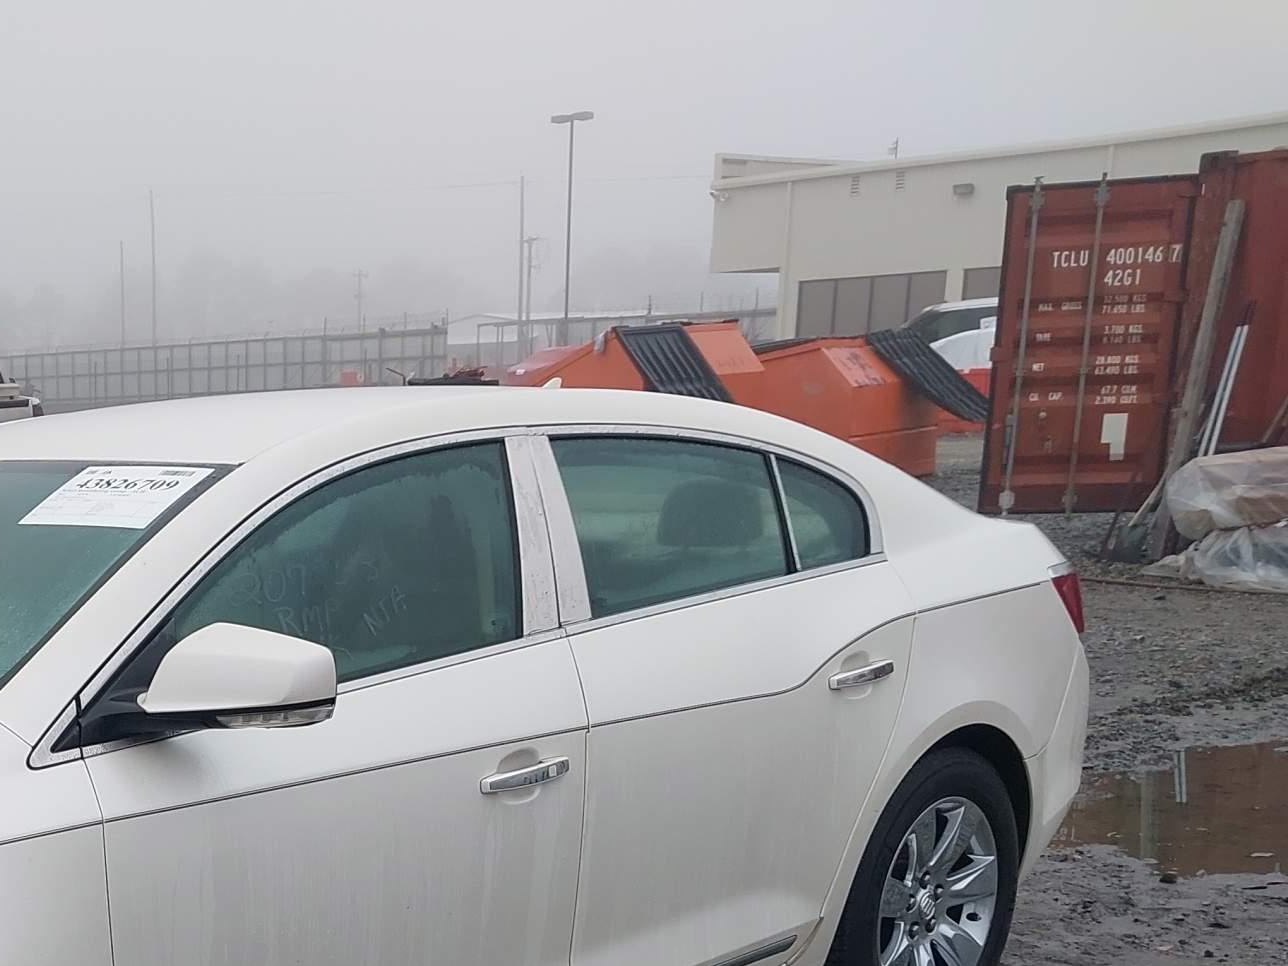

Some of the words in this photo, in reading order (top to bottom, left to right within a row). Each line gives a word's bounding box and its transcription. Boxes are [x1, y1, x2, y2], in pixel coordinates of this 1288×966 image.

[1052, 250, 1089, 268] TCLU
[1106, 246, 1164, 265] 400146
[1168, 244, 1183, 263] 7
[1104, 269, 1141, 286] 42G1
[76, 478, 180, 491] 43826709
